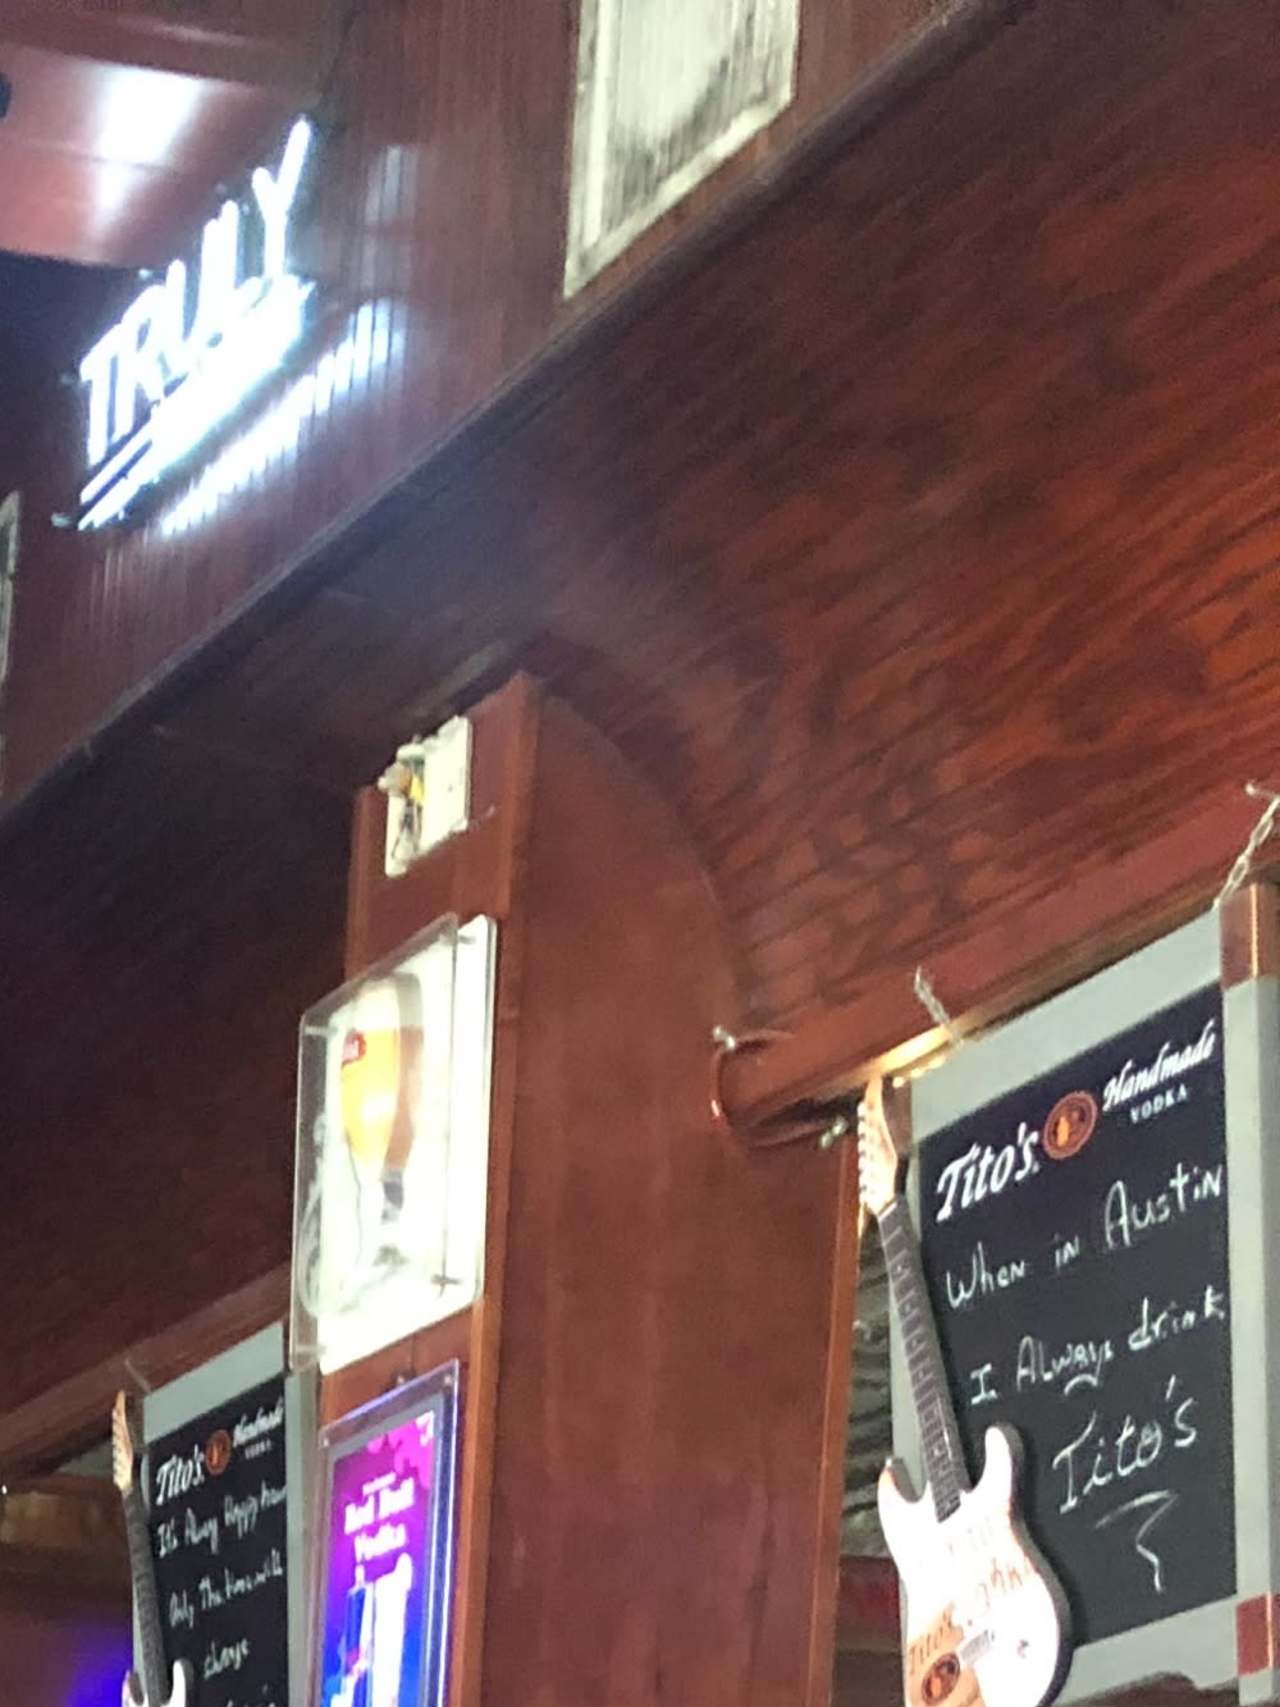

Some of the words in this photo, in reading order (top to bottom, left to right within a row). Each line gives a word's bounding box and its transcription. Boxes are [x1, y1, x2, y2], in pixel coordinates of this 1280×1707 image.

[81, 120, 310, 465] TRULY
[936, 1121, 1040, 1223] Tito's
[1102, 1018, 1216, 1113] Handmade
[1129, 1082, 1188, 1124] VODKA
[946, 1241, 1026, 1310] When
[1054, 1232, 1080, 1268] in
[1103, 1162, 1223, 1250] Austin
[969, 1363, 998, 1405] I
[1128, 1284, 1226, 1352] drink
[155, 1442, 206, 1507] Tito's
[1051, 1373, 1198, 1514] Tito's
